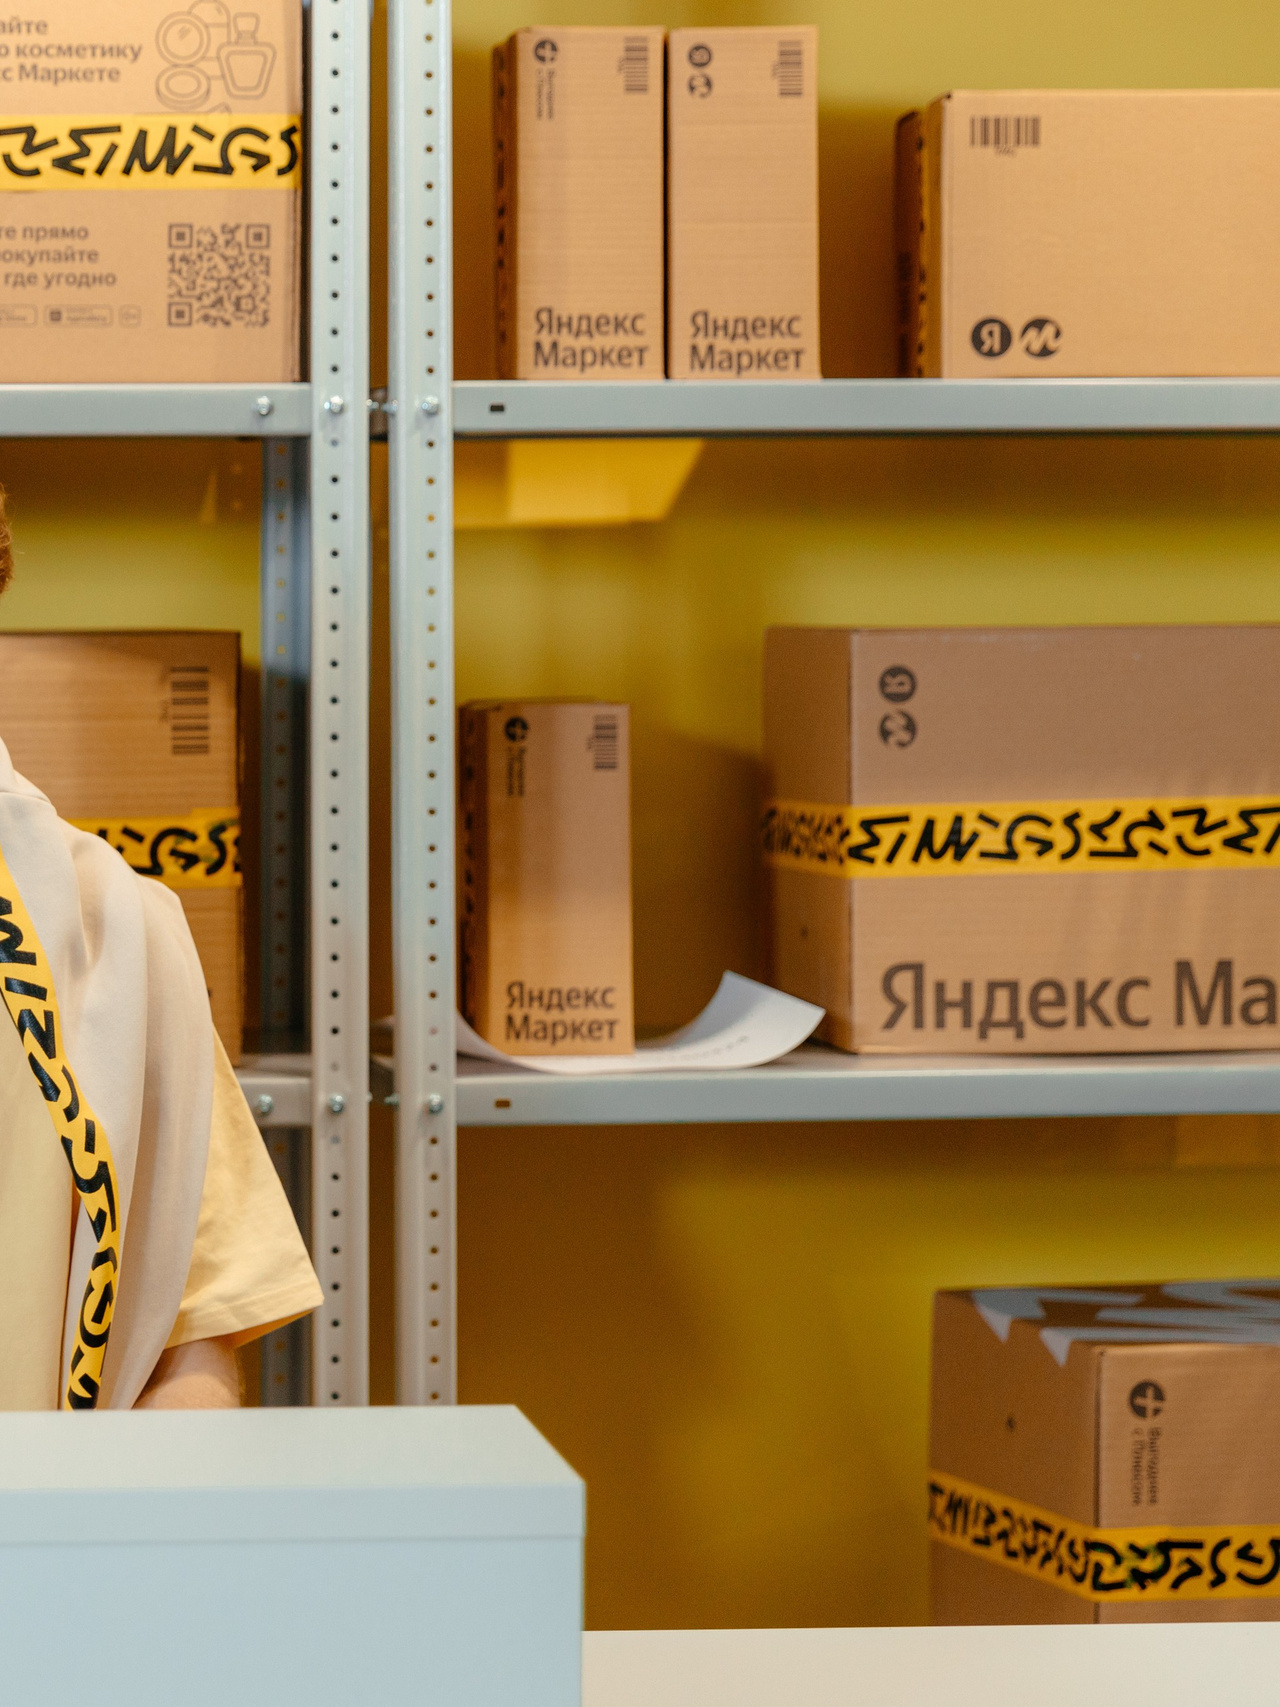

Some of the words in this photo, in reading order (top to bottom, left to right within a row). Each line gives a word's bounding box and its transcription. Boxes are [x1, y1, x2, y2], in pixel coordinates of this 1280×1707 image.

[16, 41, 143, 62] косметику
[18, 63, 121, 85] Маркете
[22, 224, 89, 242] прямо
[5, 270, 38, 288] где
[44, 270, 117, 290] угодно
[534, 307, 646, 339] Яндекс
[690, 311, 802, 342] Яндекс
[533, 341, 649, 374] Маркет
[689, 344, 805, 376] Маркет
[505, 981, 616, 1013] Яндекс
[880, 960, 1152, 1041] Яндекс
[505, 1015, 619, 1046] Маркет
